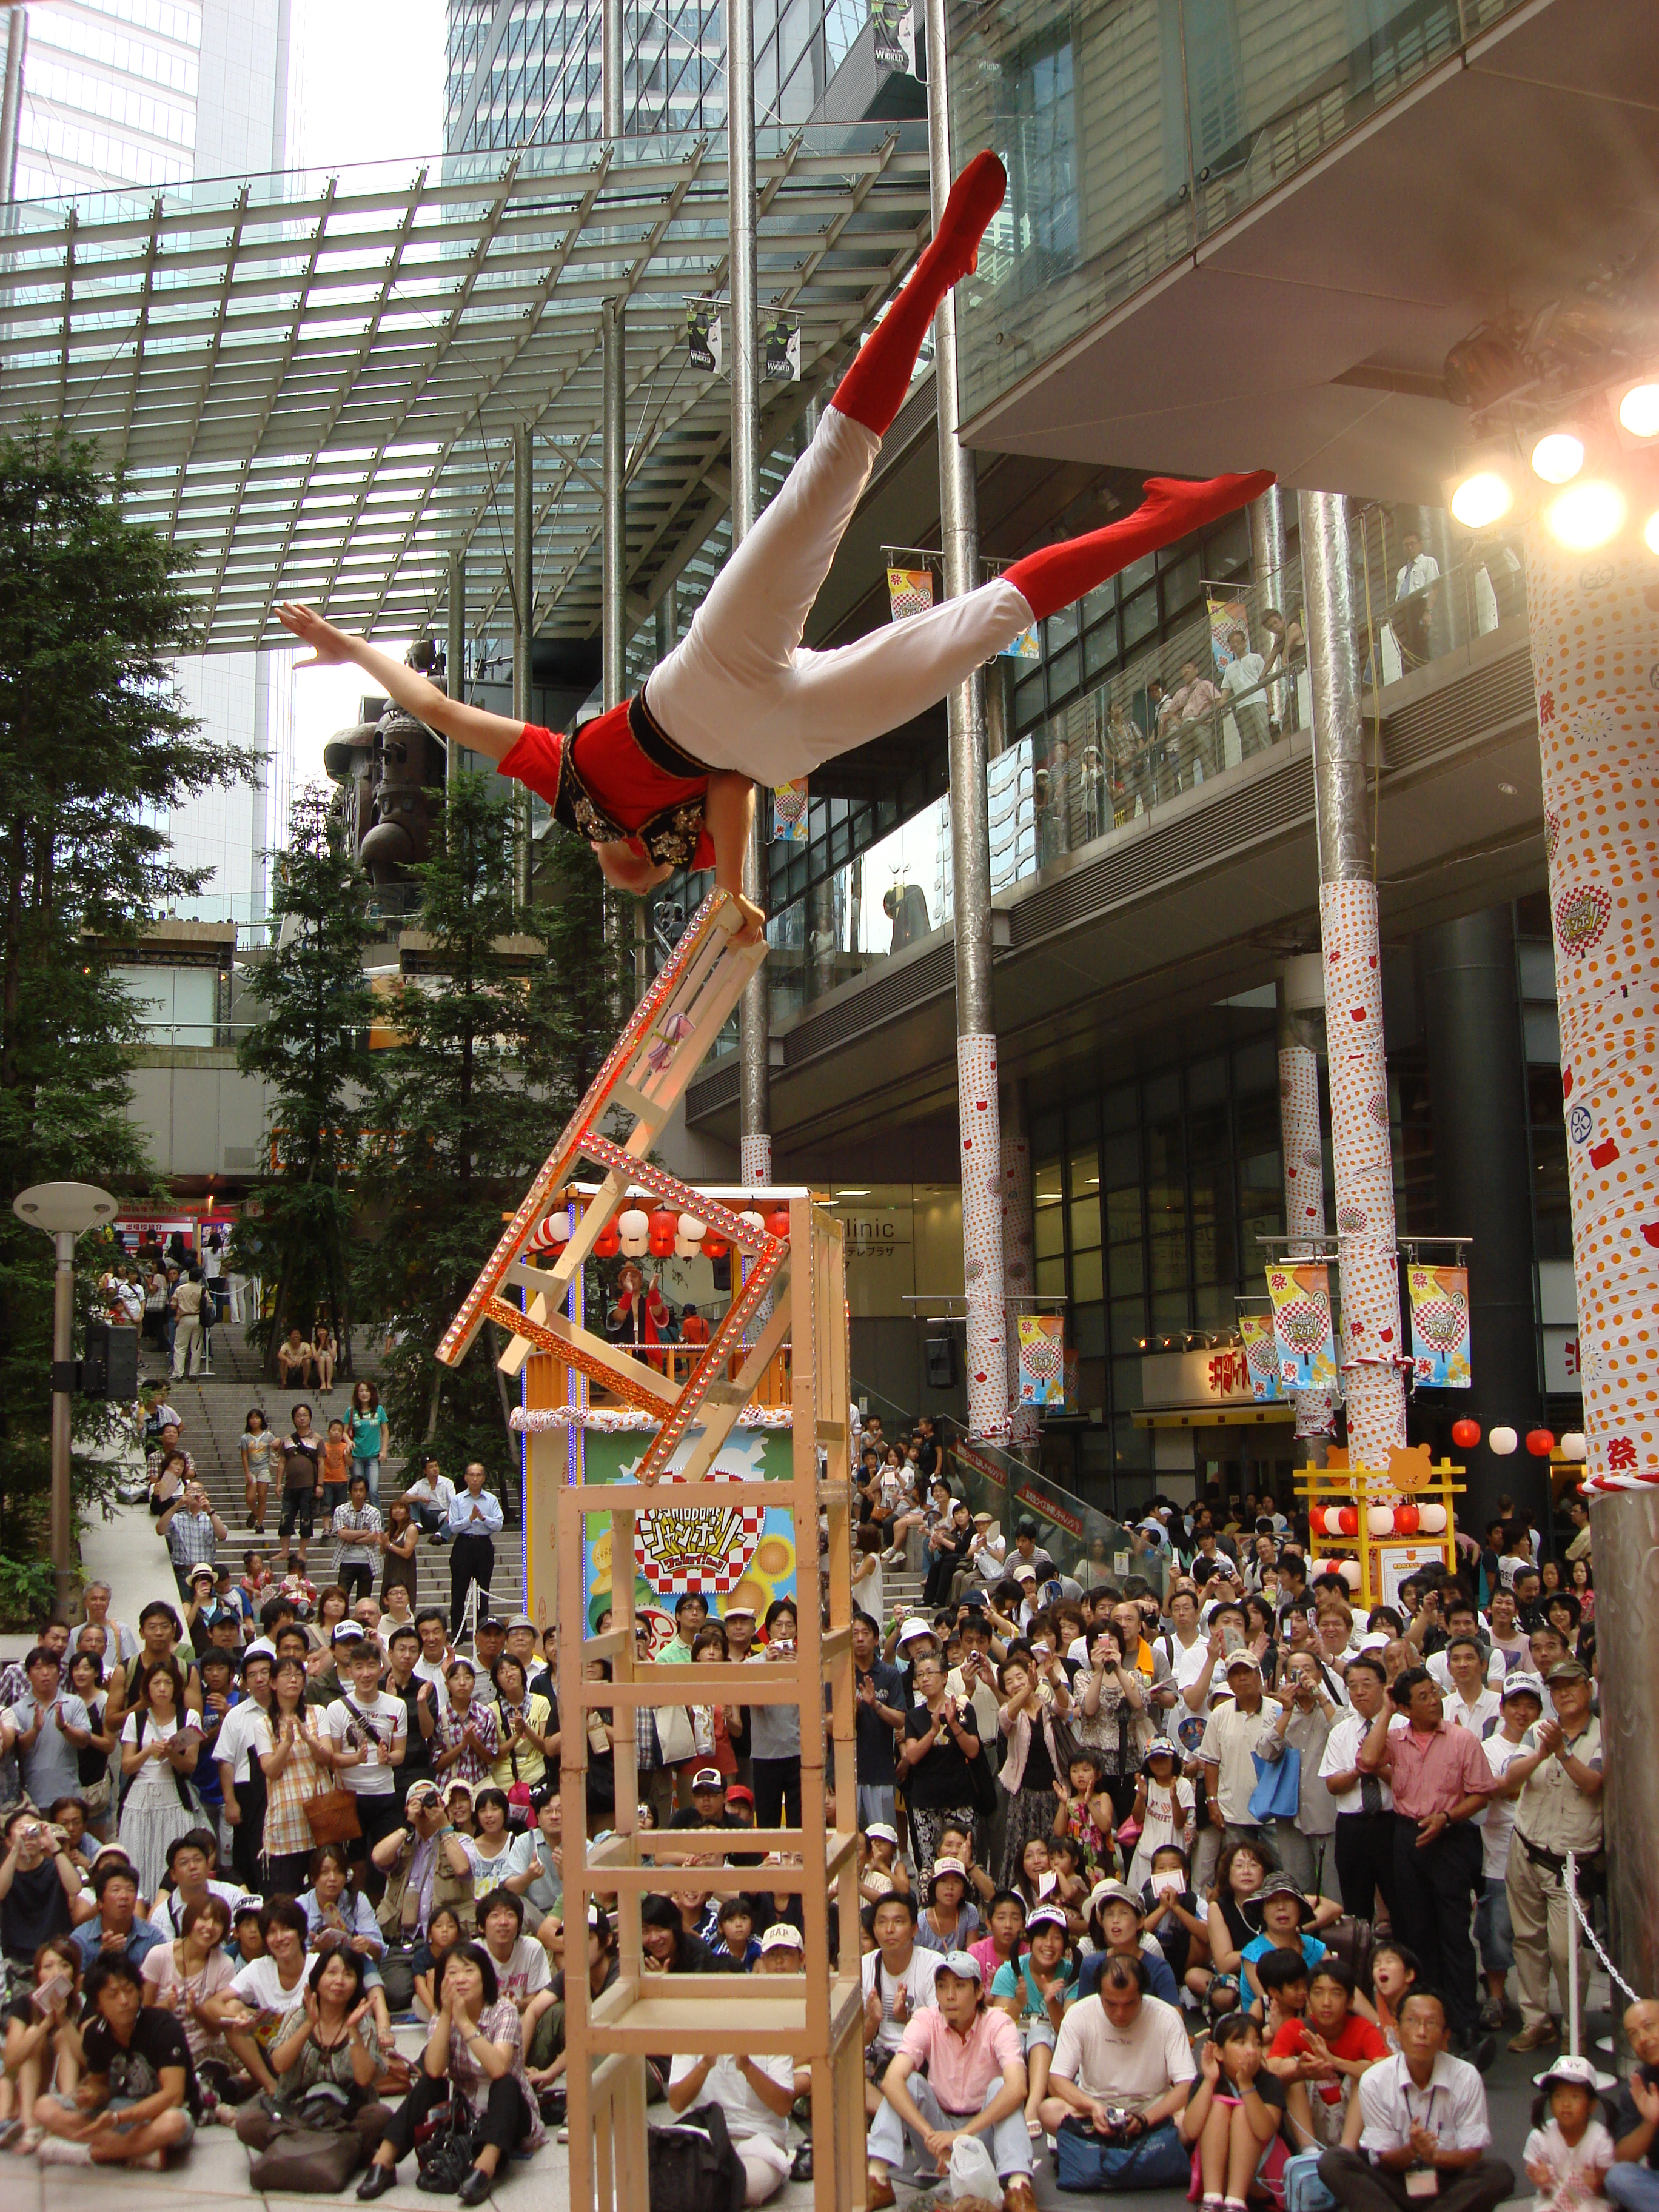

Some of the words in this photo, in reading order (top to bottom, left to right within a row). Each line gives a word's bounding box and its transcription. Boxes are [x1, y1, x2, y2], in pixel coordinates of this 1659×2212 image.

[836, 1218, 894, 1238] linic
[1271, 1273, 1287, 1290] 祭
[1413, 1273, 1427, 1289] 祭
[1607, 1436, 1638, 1470] 祭
[770, 1928, 788, 1939] GAP
